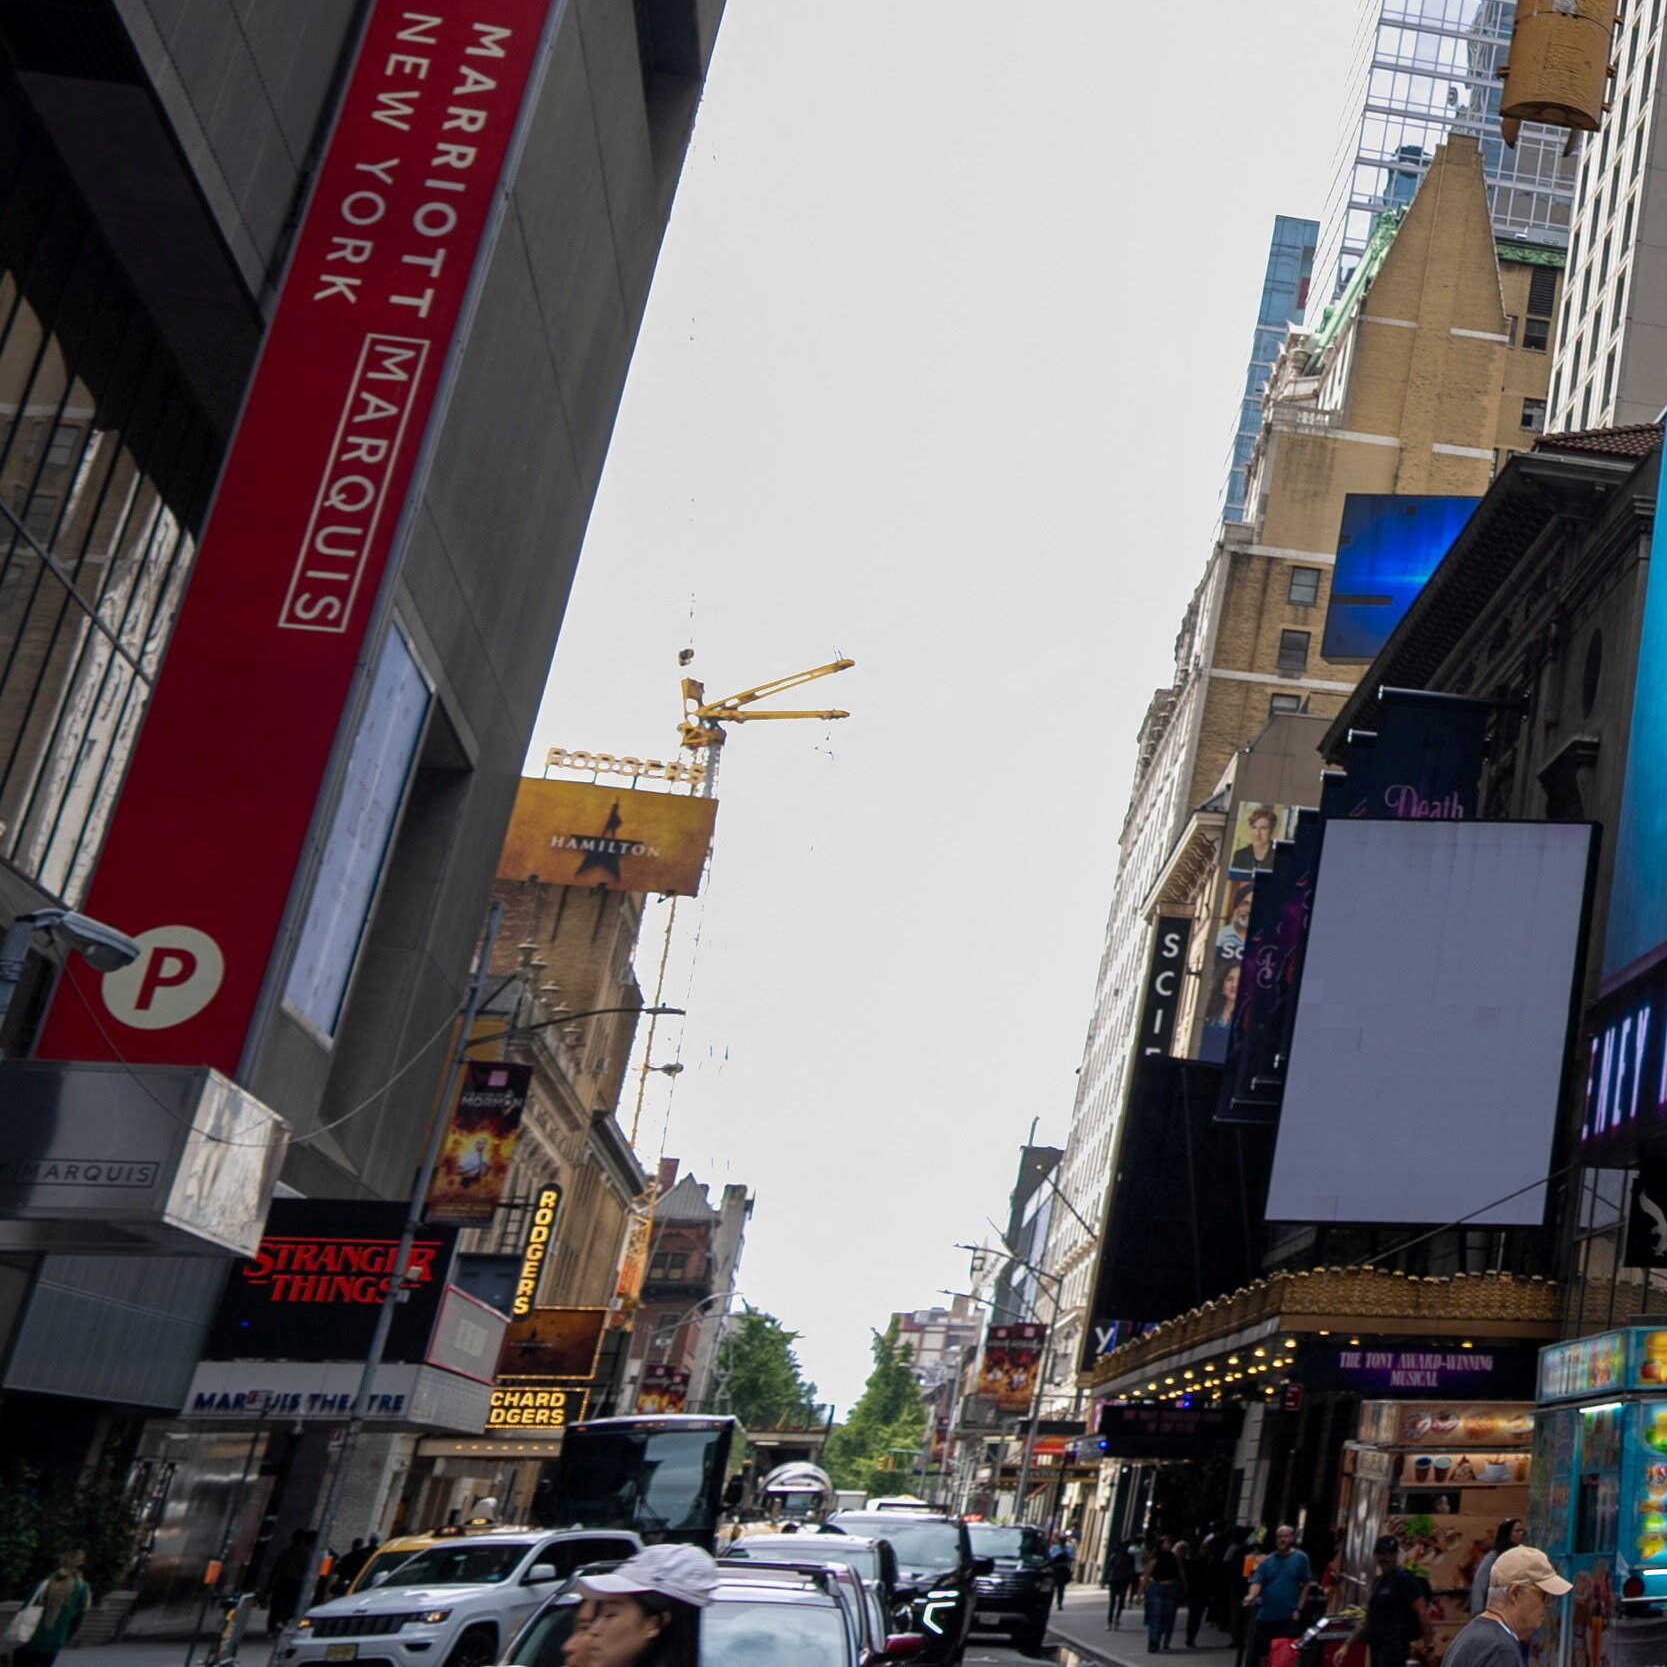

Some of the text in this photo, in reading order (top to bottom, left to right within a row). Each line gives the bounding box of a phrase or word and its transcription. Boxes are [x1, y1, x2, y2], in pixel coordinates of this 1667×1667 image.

[313, 12, 444, 304] NEW YORK
[294, 22, 513, 623] MARRIOTT MARQUIS
[546, 747, 706, 785] RODGERS
[1384, 784, 1465, 818] Death
[550, 836, 661, 857] HAMILTON
[135, 947, 196, 1012] P
[1144, 932, 1182, 1056] SCI
[24, 1163, 151, 1183] MARQUIS
[513, 1190, 559, 1315] RODGERS
[270, 1273, 394, 1305] THINGS
[1339, 1351, 1363, 1368] THE
[1395, 1352, 1494, 1372] AWARD-WINNING
[1389, 1370, 1439, 1388] MUSICAL
[194, 1392, 406, 1412] MARUIS THETRE
[490, 1391, 566, 1408] CHARD
[490, 1408, 566, 1425] DGERS
